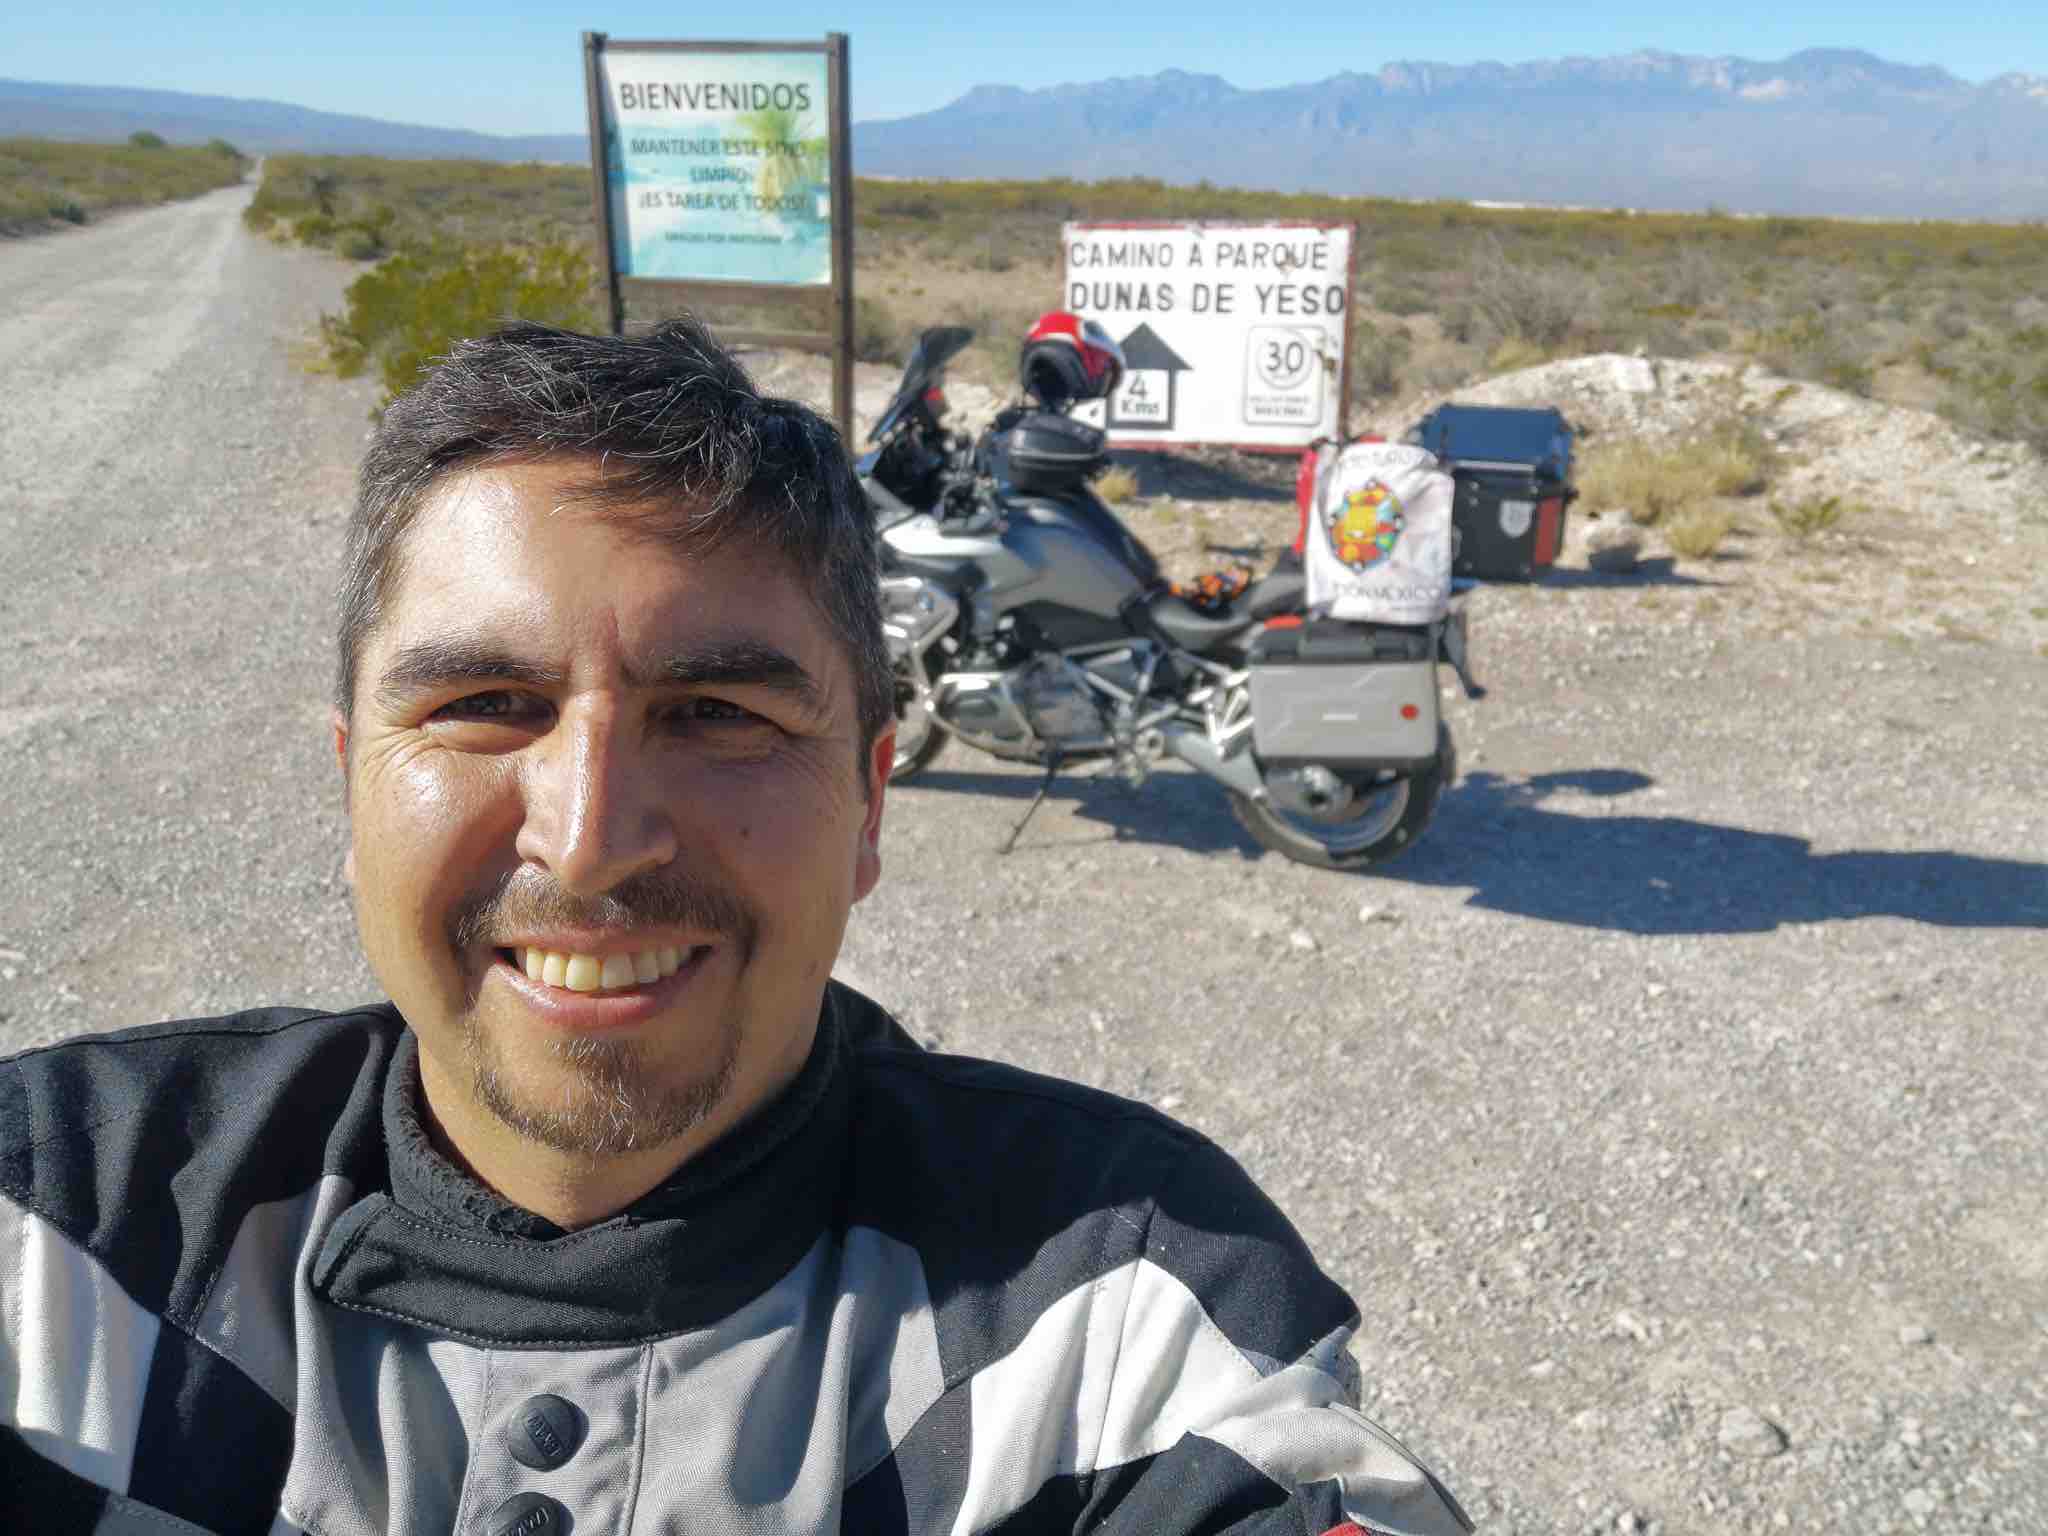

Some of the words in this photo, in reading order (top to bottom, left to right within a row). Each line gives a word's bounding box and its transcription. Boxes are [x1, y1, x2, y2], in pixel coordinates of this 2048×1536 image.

[619, 82, 811, 112] BIENVENIDOS
[630, 138, 720, 156] MANTENER
[665, 192, 716, 209] TAREA
[719, 193, 738, 210] DE
[1071, 242, 1174, 268] CAMINO
[1186, 242, 1204, 268] A
[1215, 242, 1329, 271] PARQUE
[1070, 281, 1175, 312] DUNAS
[1191, 282, 1236, 314] DE
[1255, 283, 1346, 316] YESO
[1265, 340, 1305, 375] 30
[1128, 371, 1149, 400] 4
